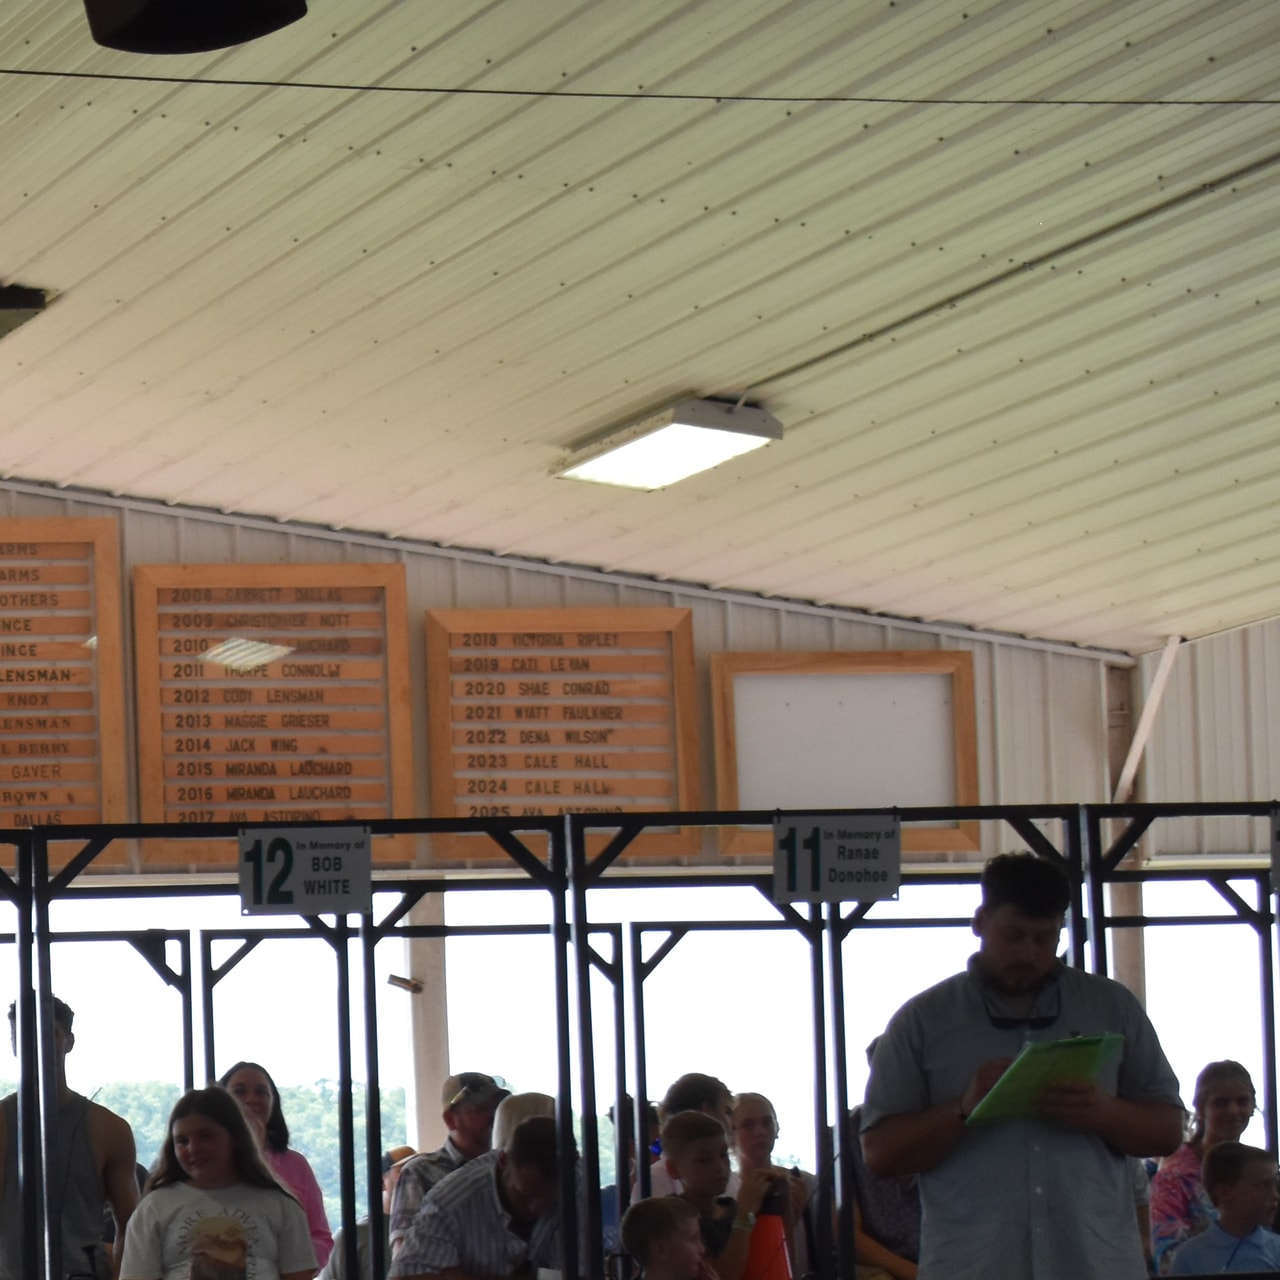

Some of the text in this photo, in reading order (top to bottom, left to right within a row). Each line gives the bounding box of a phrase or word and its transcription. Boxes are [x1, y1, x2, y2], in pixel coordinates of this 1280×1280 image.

[465, 682, 610, 696] 2020 SHAE CONRAD
[7, 693, 50, 707] KNOX
[465, 706, 623, 720] 2021 WYATT FAULKNER
[175, 714, 330, 728] 2013 MAGGIE GRIESER
[175, 738, 299, 753] 2014 JACK WING
[176, 761, 353, 776] 2015 MIRANDA LAUCHARD
[467, 755, 609, 769] 2023 CALE HALL
[177, 786, 351, 801] 2016 MIRANDA LAUCHARD
[823, 829, 896, 842] In Memory of
[295, 840, 366, 852] In Memory of
[837, 845, 880, 860] Ranae
[311, 856, 343, 872] BOB
[778, 826, 821, 893] 11
[243, 837, 294, 906] 12
[828, 868, 889, 883] Donohoe
[303, 879, 351, 895] WHITE
